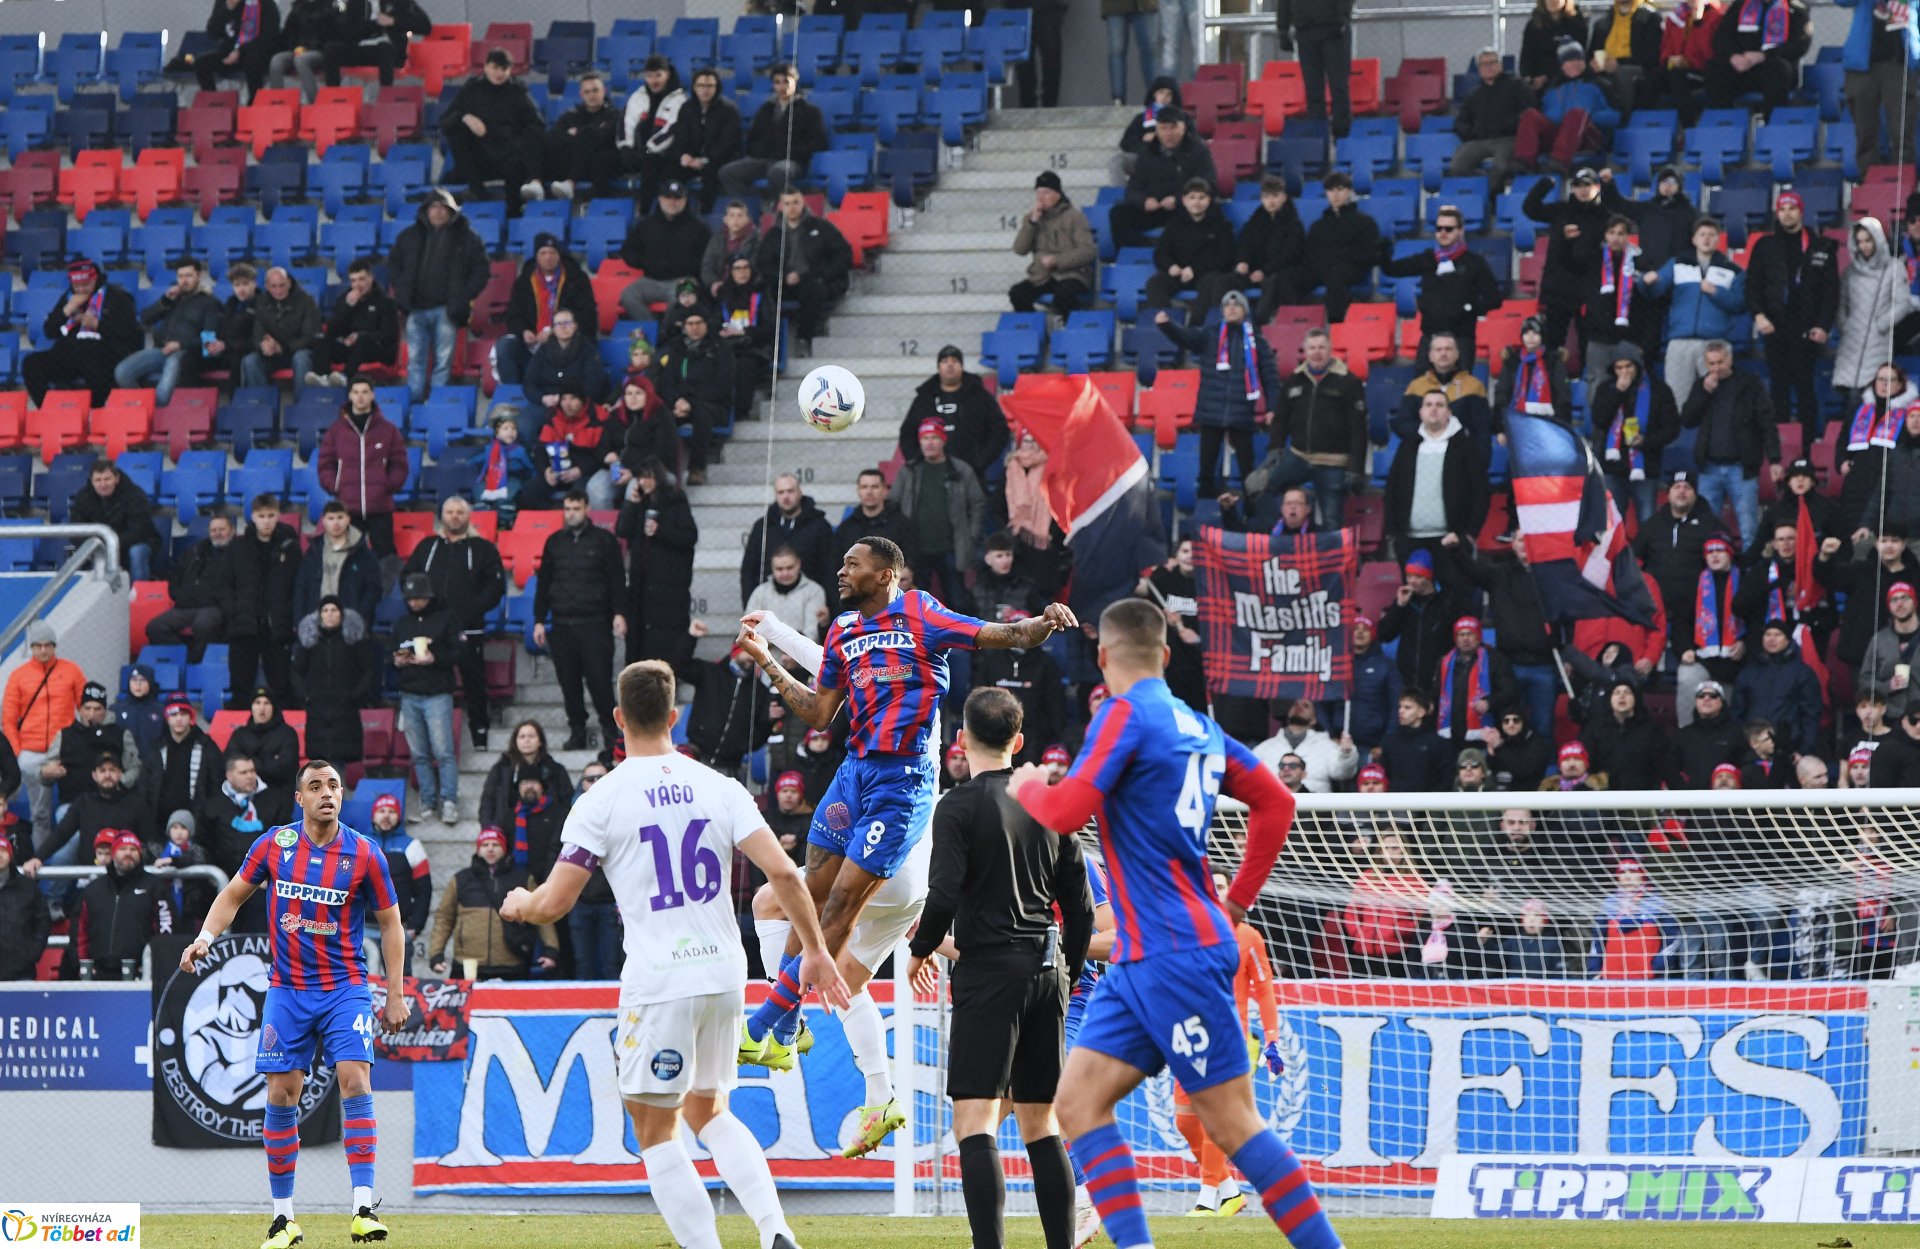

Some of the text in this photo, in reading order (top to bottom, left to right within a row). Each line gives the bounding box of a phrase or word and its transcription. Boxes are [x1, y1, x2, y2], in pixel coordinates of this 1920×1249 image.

[1050, 153, 1068, 169] 15
[1000, 214, 1018, 230] 14
[950, 277, 968, 294] 13
[900, 340, 919, 356] 12
[796, 467, 815, 483] 10
[1262, 556, 1302, 595] the
[1233, 589, 1342, 632] Mastiffs
[1250, 630, 1333, 682] Family
[644, 780, 694, 809] VÁGÓ
[866, 820, 886, 845] 8
[639, 818, 722, 913] 16
[193, 939, 238, 977] ANTI
[352, 1014, 373, 1036] 44
[1171, 1015, 1210, 1058] 45
[0, 1044, 100, 1059] ÁNKLINIKA
[162, 1057, 264, 1136] DESTROY THE
